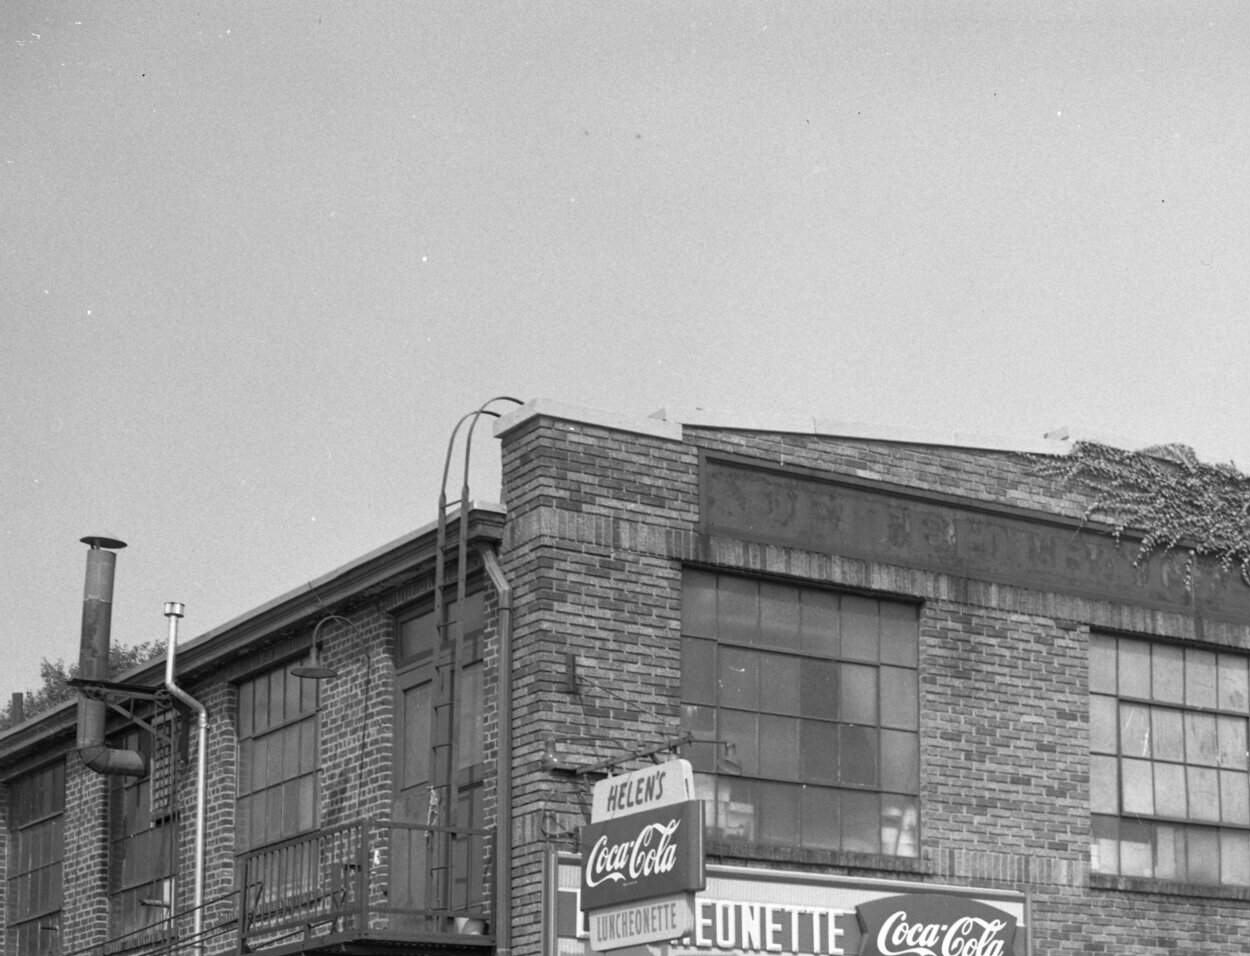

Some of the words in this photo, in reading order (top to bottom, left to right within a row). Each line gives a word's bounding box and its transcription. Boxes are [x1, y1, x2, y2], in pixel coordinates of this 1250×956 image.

[606, 770, 666, 812] HELEN'S
[585, 818, 682, 888] Coca-Cola
[596, 903, 677, 942] LUNCHEONETTE
